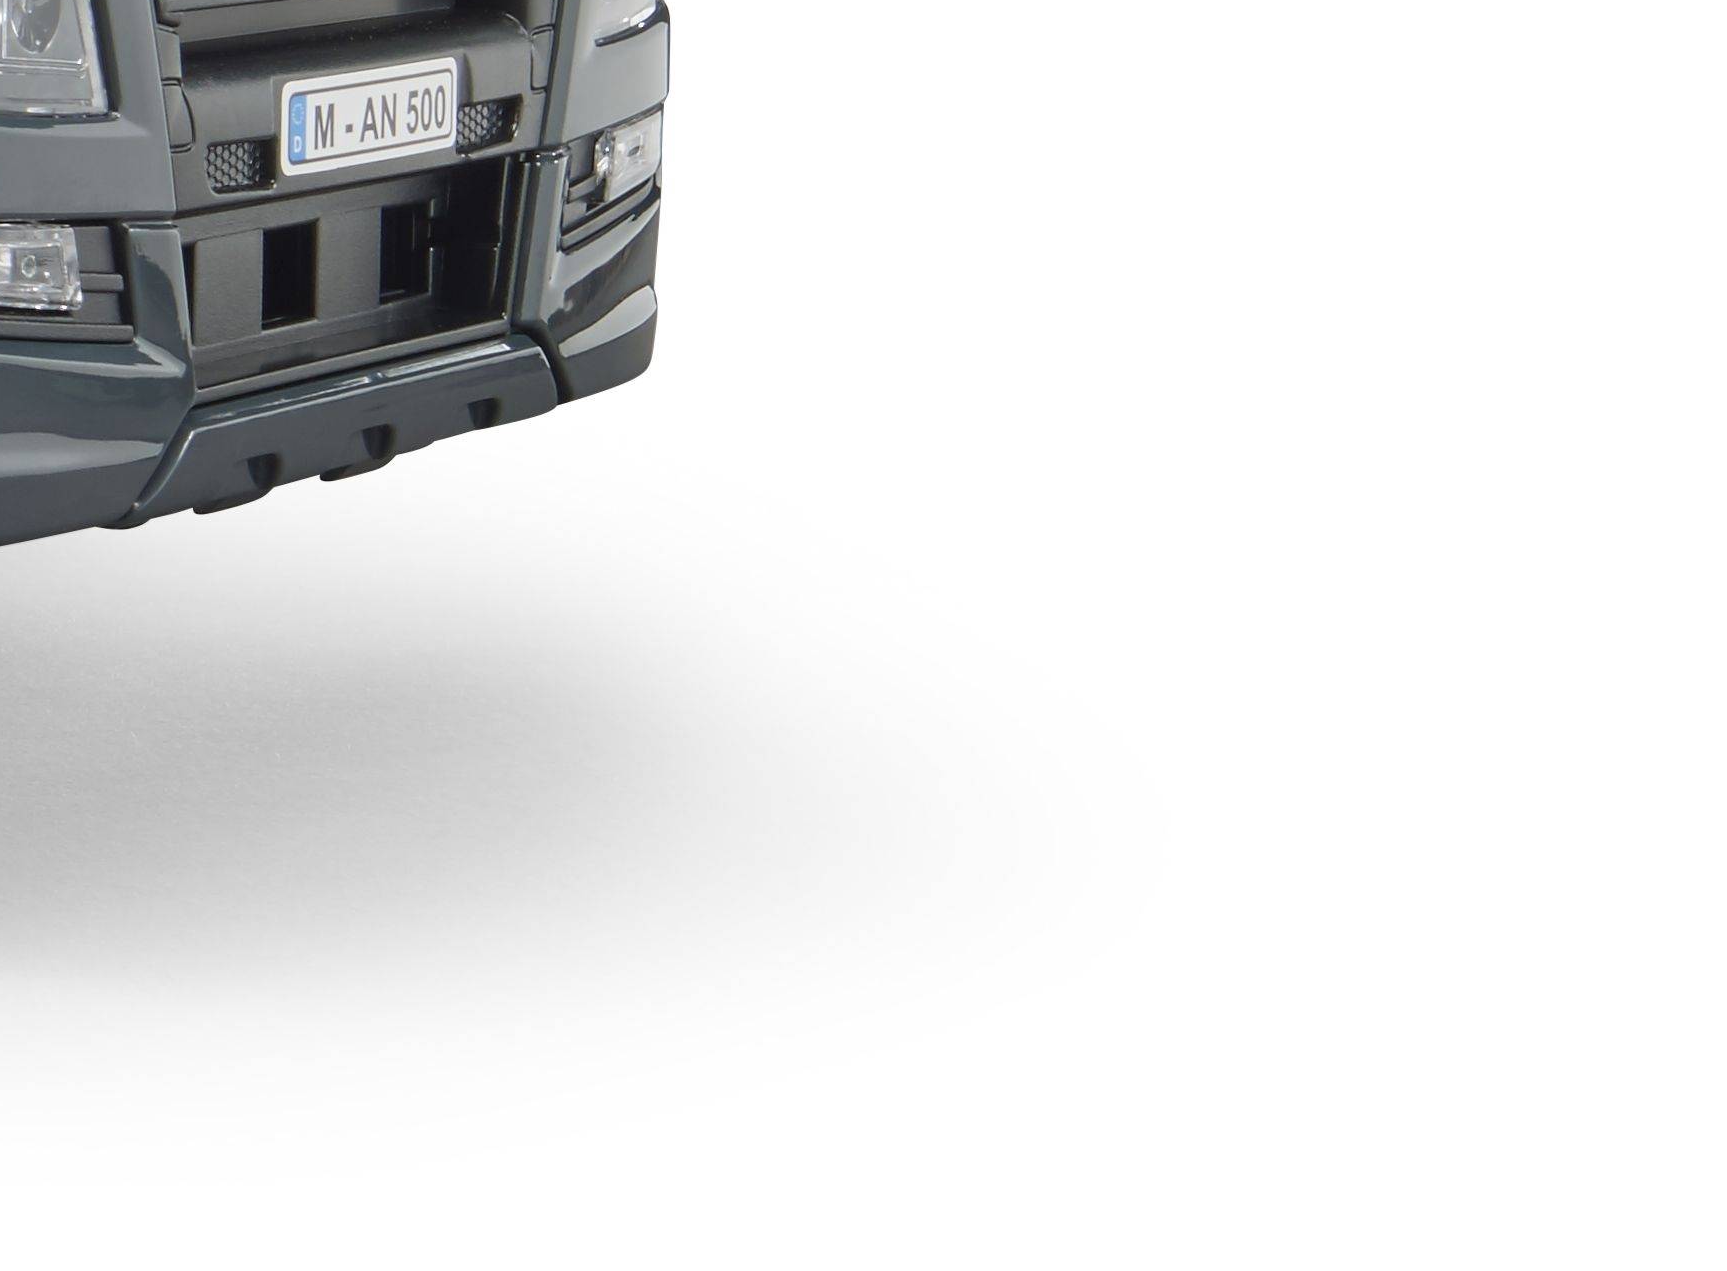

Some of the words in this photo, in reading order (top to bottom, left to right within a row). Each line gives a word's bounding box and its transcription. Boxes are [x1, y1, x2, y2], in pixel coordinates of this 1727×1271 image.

[314, 103, 335, 150] M
[360, 92, 398, 142] AN
[407, 85, 446, 134] 500
